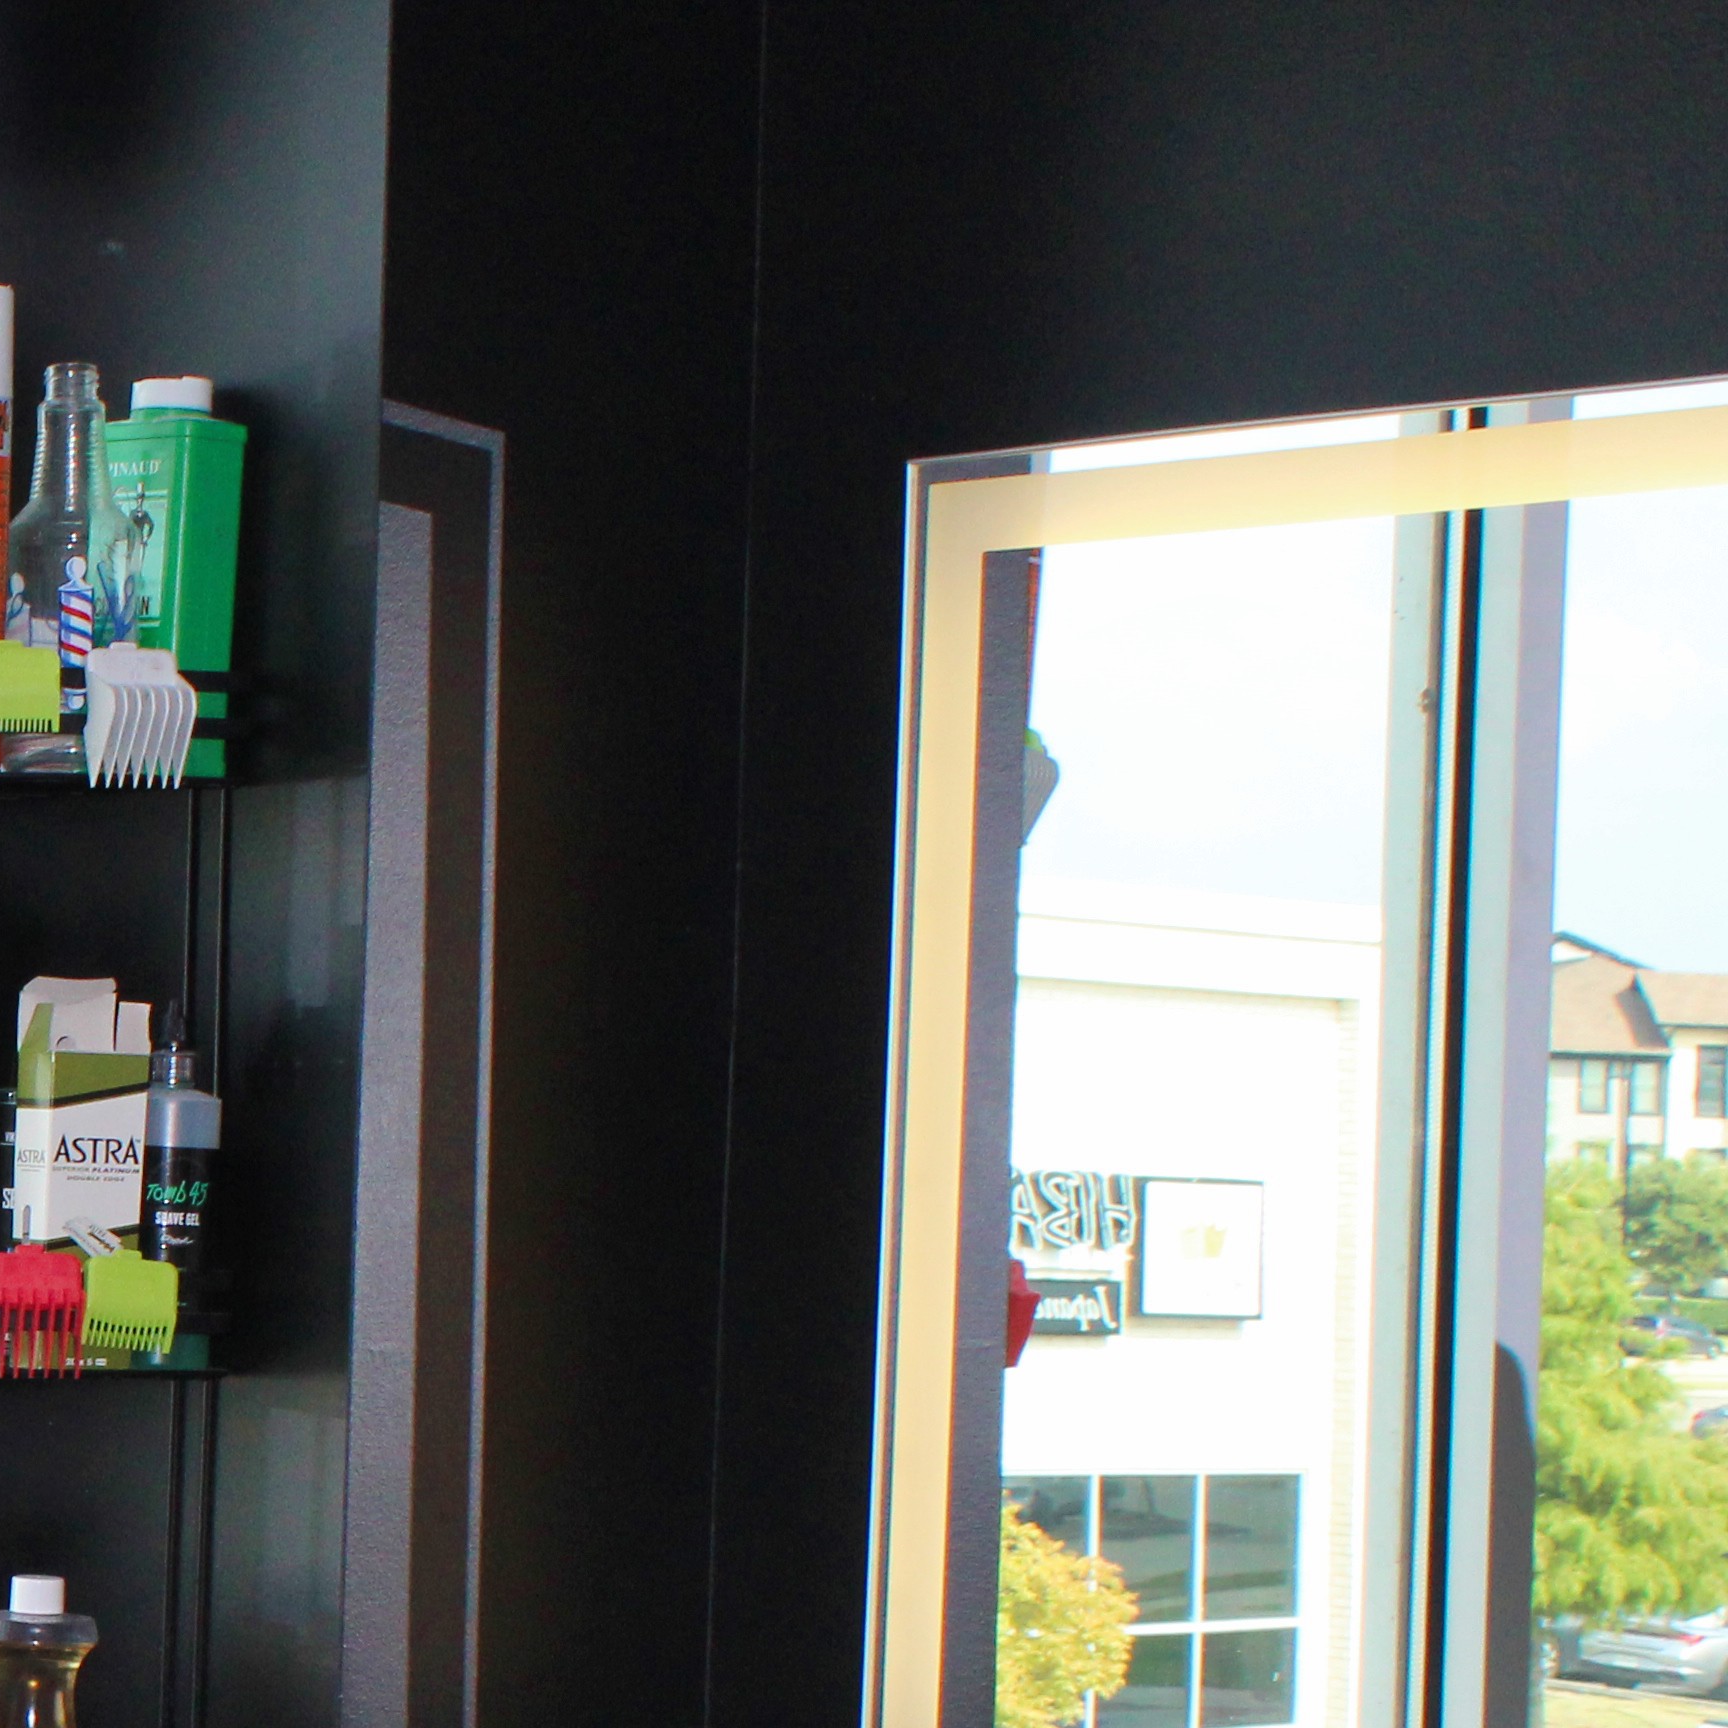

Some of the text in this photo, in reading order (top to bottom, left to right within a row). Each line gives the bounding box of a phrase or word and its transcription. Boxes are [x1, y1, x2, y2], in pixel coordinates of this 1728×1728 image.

[17, 1149, 45, 1164] ASTRA
[54, 1134, 140, 1166] ASTRA
[91, 1166, 141, 1175] PLATINUM
[189, 1181, 209, 1206] 45
[155, 1211, 200, 1227] SHAVE GEL
